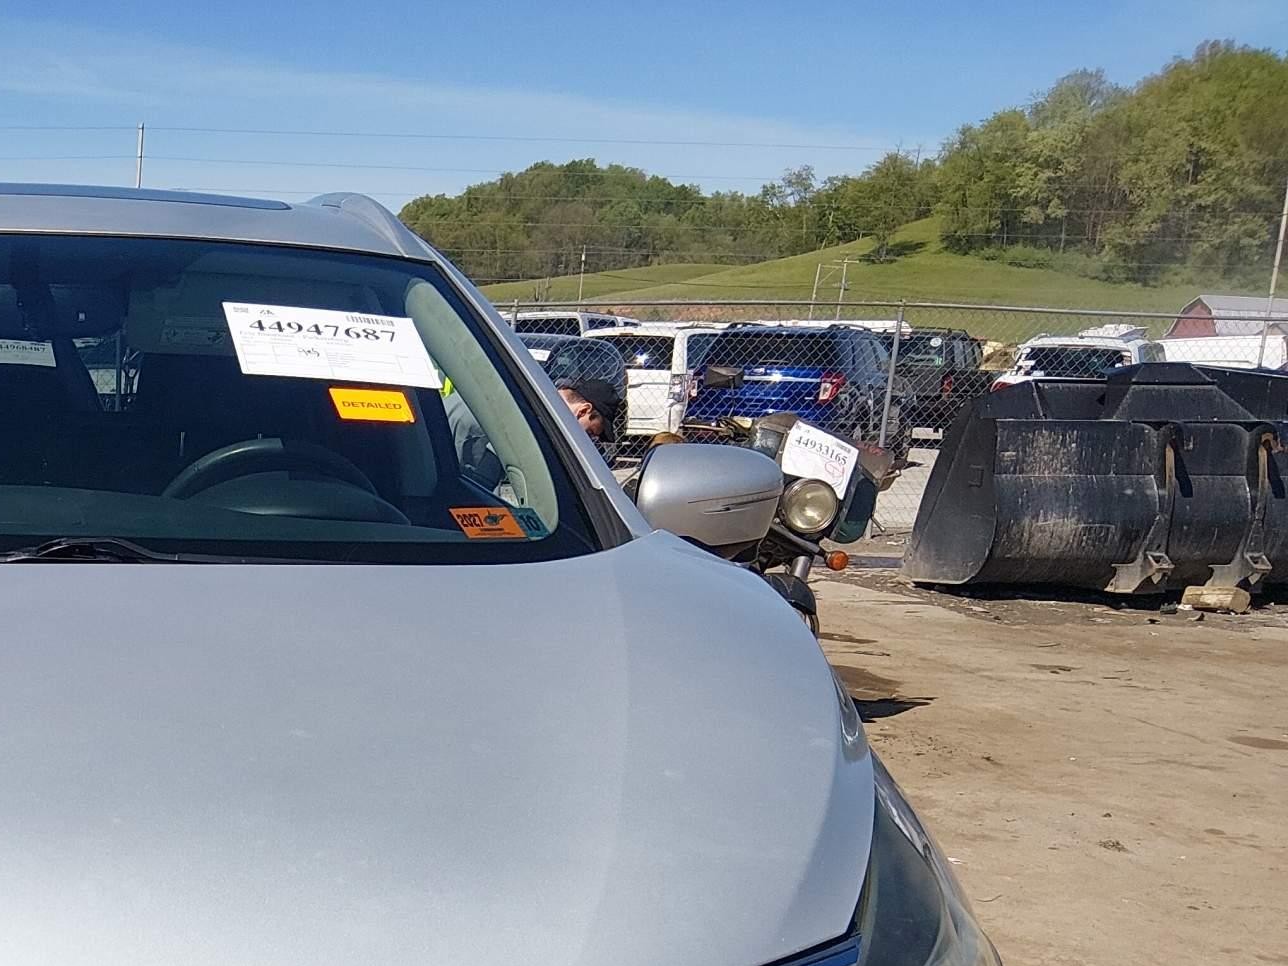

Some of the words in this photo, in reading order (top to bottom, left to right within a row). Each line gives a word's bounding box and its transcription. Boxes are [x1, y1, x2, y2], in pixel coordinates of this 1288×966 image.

[249, 319, 396, 343] 44947687
[341, 401, 403, 411] DETAILED
[795, 435, 849, 467] 44933165
[455, 512, 484, 528] 2027
[518, 513, 541, 532] 10
